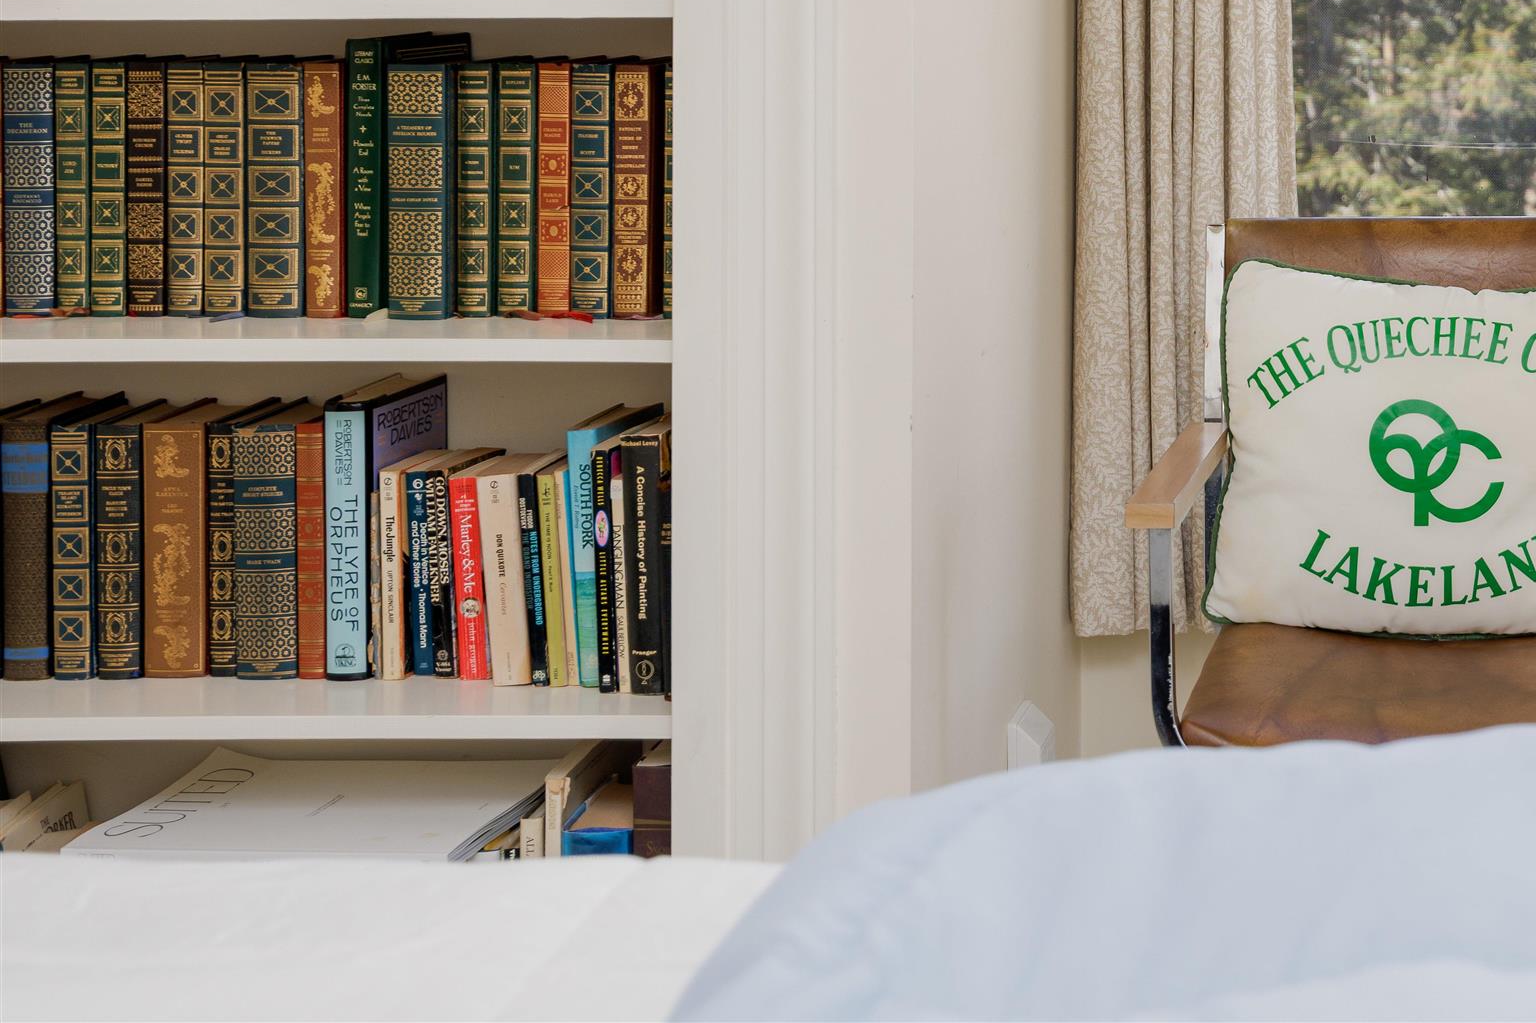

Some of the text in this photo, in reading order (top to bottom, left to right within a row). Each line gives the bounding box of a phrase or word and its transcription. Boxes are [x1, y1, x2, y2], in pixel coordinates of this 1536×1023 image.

[352, 83, 376, 91] FORSTER
[1247, 337, 1325, 409] THE
[1326, 316, 1513, 374] QUECHEE
[377, 392, 444, 431] ROBERTSON
[390, 415, 432, 446] DAVIES
[460, 515, 474, 554] Marley
[579, 464, 594, 549] SOUTH FORK
[330, 507, 343, 621] ORPHEUS
[345, 494, 359, 631] THE LYRE OF
[385, 516, 395, 562] The Jungle
[439, 542, 449, 584] MOSES
[637, 466, 648, 619] A Concise History of Painting
[430, 536, 439, 602] FAULKNER
[463, 570, 475, 593] Me
[104, 768, 254, 837] SUITED
